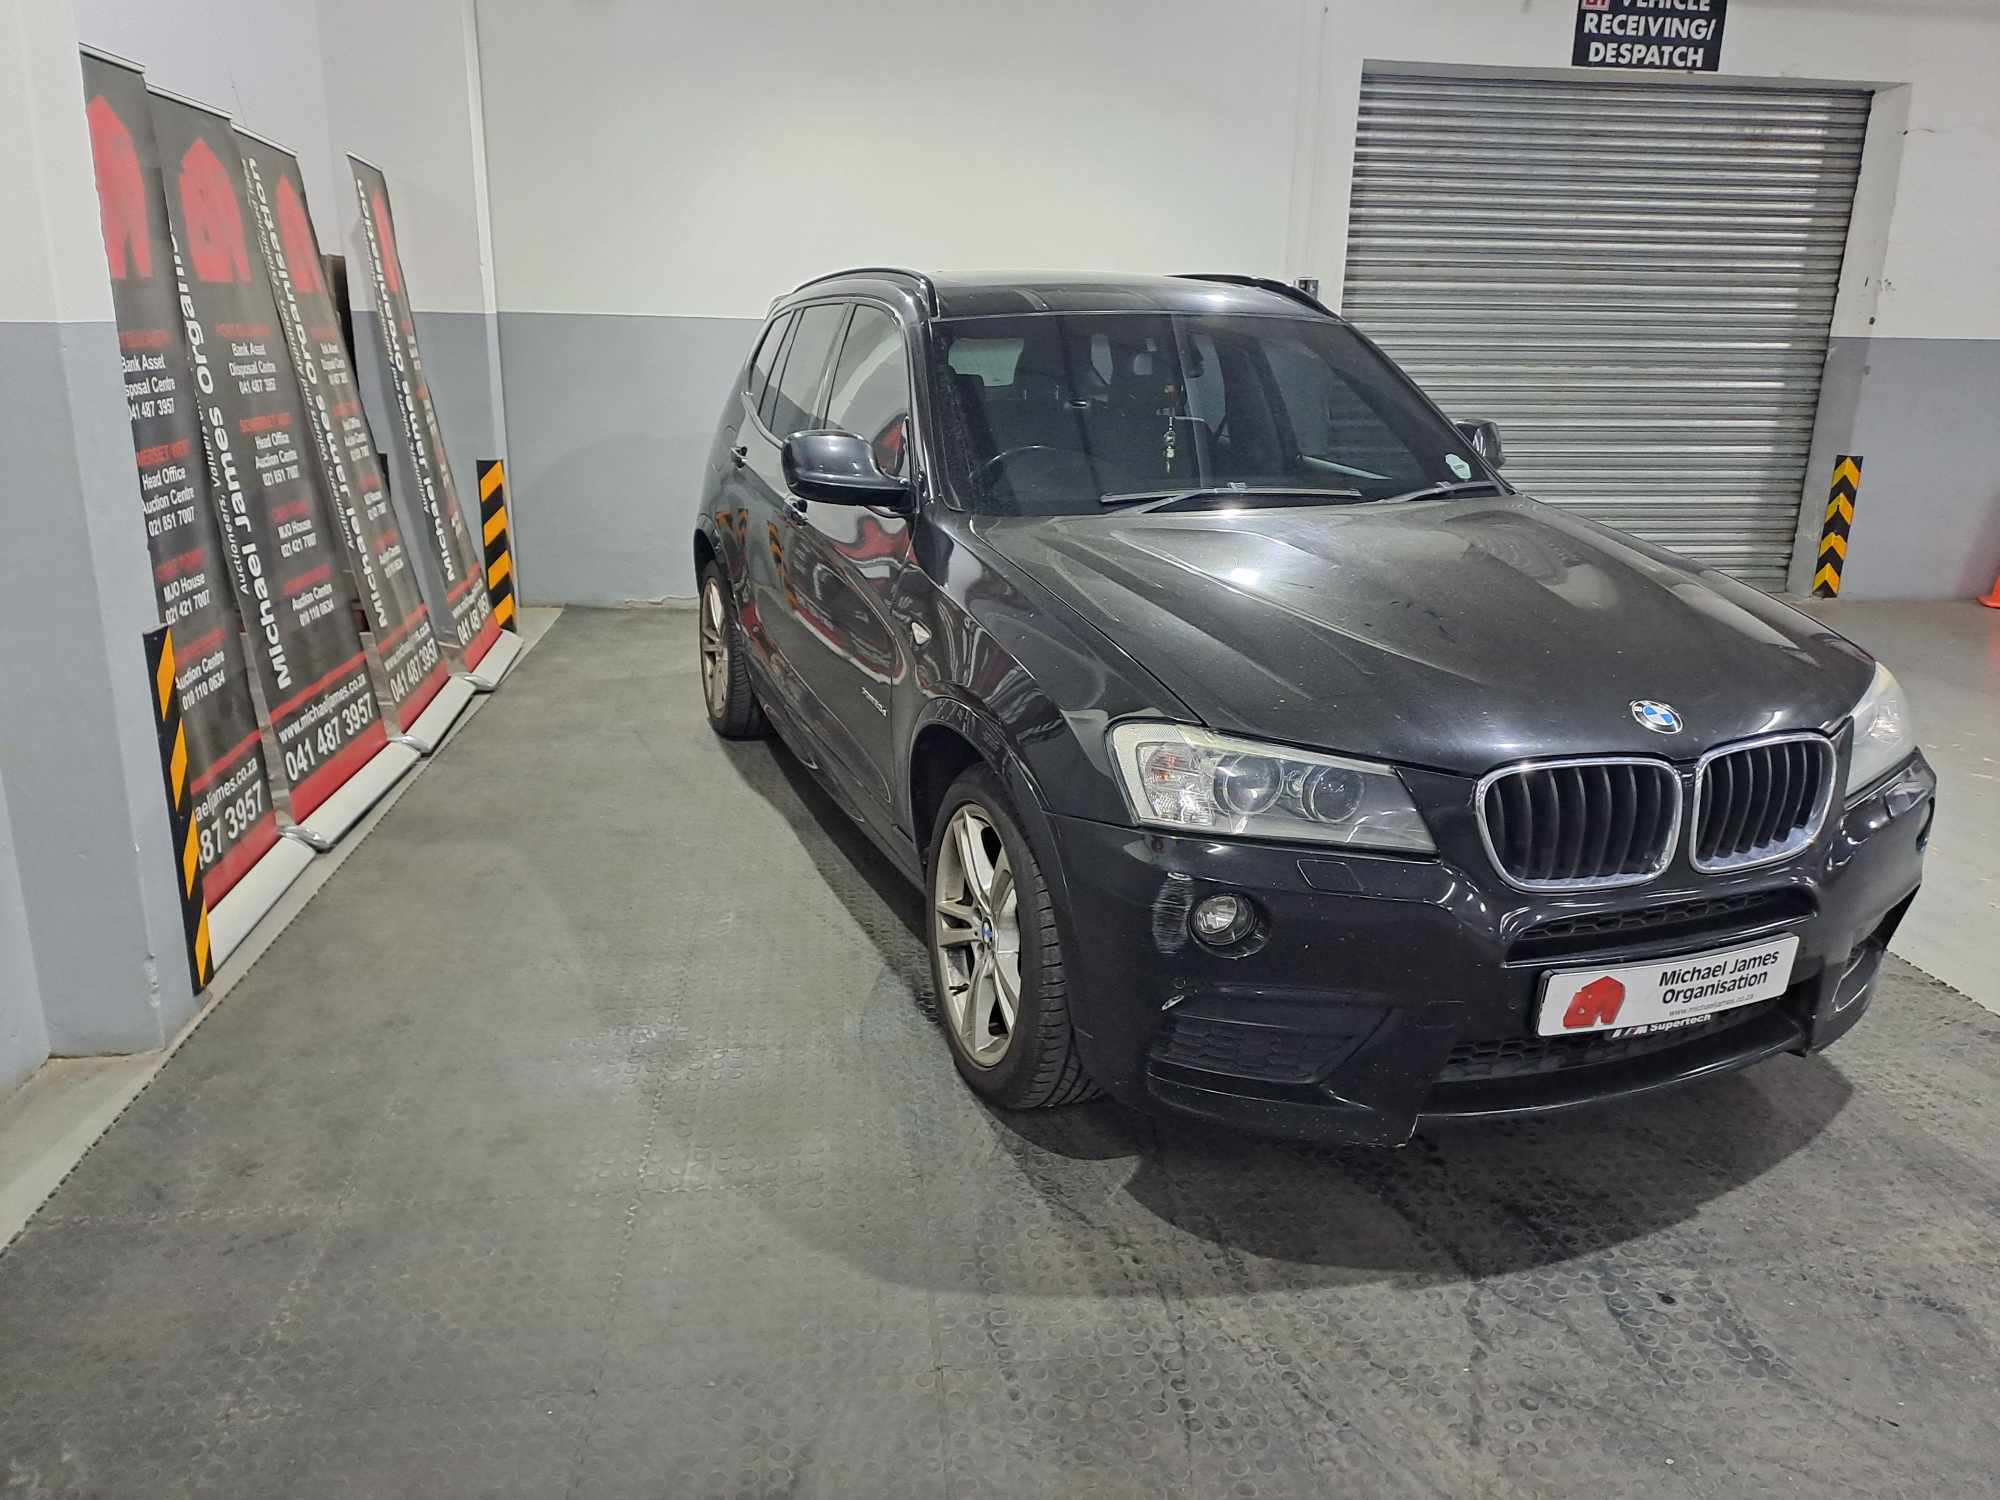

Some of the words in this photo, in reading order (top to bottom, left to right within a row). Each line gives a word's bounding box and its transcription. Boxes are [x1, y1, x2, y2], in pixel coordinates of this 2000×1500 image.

[1583, 12, 1716, 41] RECEIVING/
[1588, 42, 1704, 68] DESPATCH
[249, 157, 318, 385] Organisation
[121, 355, 140, 373] Bank
[141, 353, 166, 370] Asset
[125, 377, 150, 400] sposal
[151, 376, 175, 393] Centre
[141, 400, 155, 417] 487
[157, 397, 175, 415] 3957
[402, 380, 428, 470] James
[315, 394, 351, 498] James
[141, 470, 162, 491] Head
[161, 465, 186, 484] Office
[209, 406, 251, 532] James
[169, 486, 195, 505] Centre
[148, 519, 163, 537] 021
[219, 494, 249, 595] Auctioneers,
[423, 477, 455, 581] Michael
[346, 507, 388, 628] Michael
[163, 579, 181, 602] MJO
[180, 573, 206, 593] House
[165, 605, 180, 625] 021
[178, 599, 193, 618] 421
[242, 542, 291, 690] Michael
[390, 669, 409, 702] 041
[285, 737, 315, 781] 041
[317, 715, 341, 755] 487
[341, 692, 373, 736] 3957
[195, 757, 258, 822] aeljames.co.za
[200, 817, 222, 870] 87
[225, 779, 262, 839] 3957
[1659, 961, 1727, 987] Michael
[1729, 951, 1779, 974] James
[1662, 971, 1768, 1004] Organisation
[1650, 1014, 1712, 1033] Supertech
